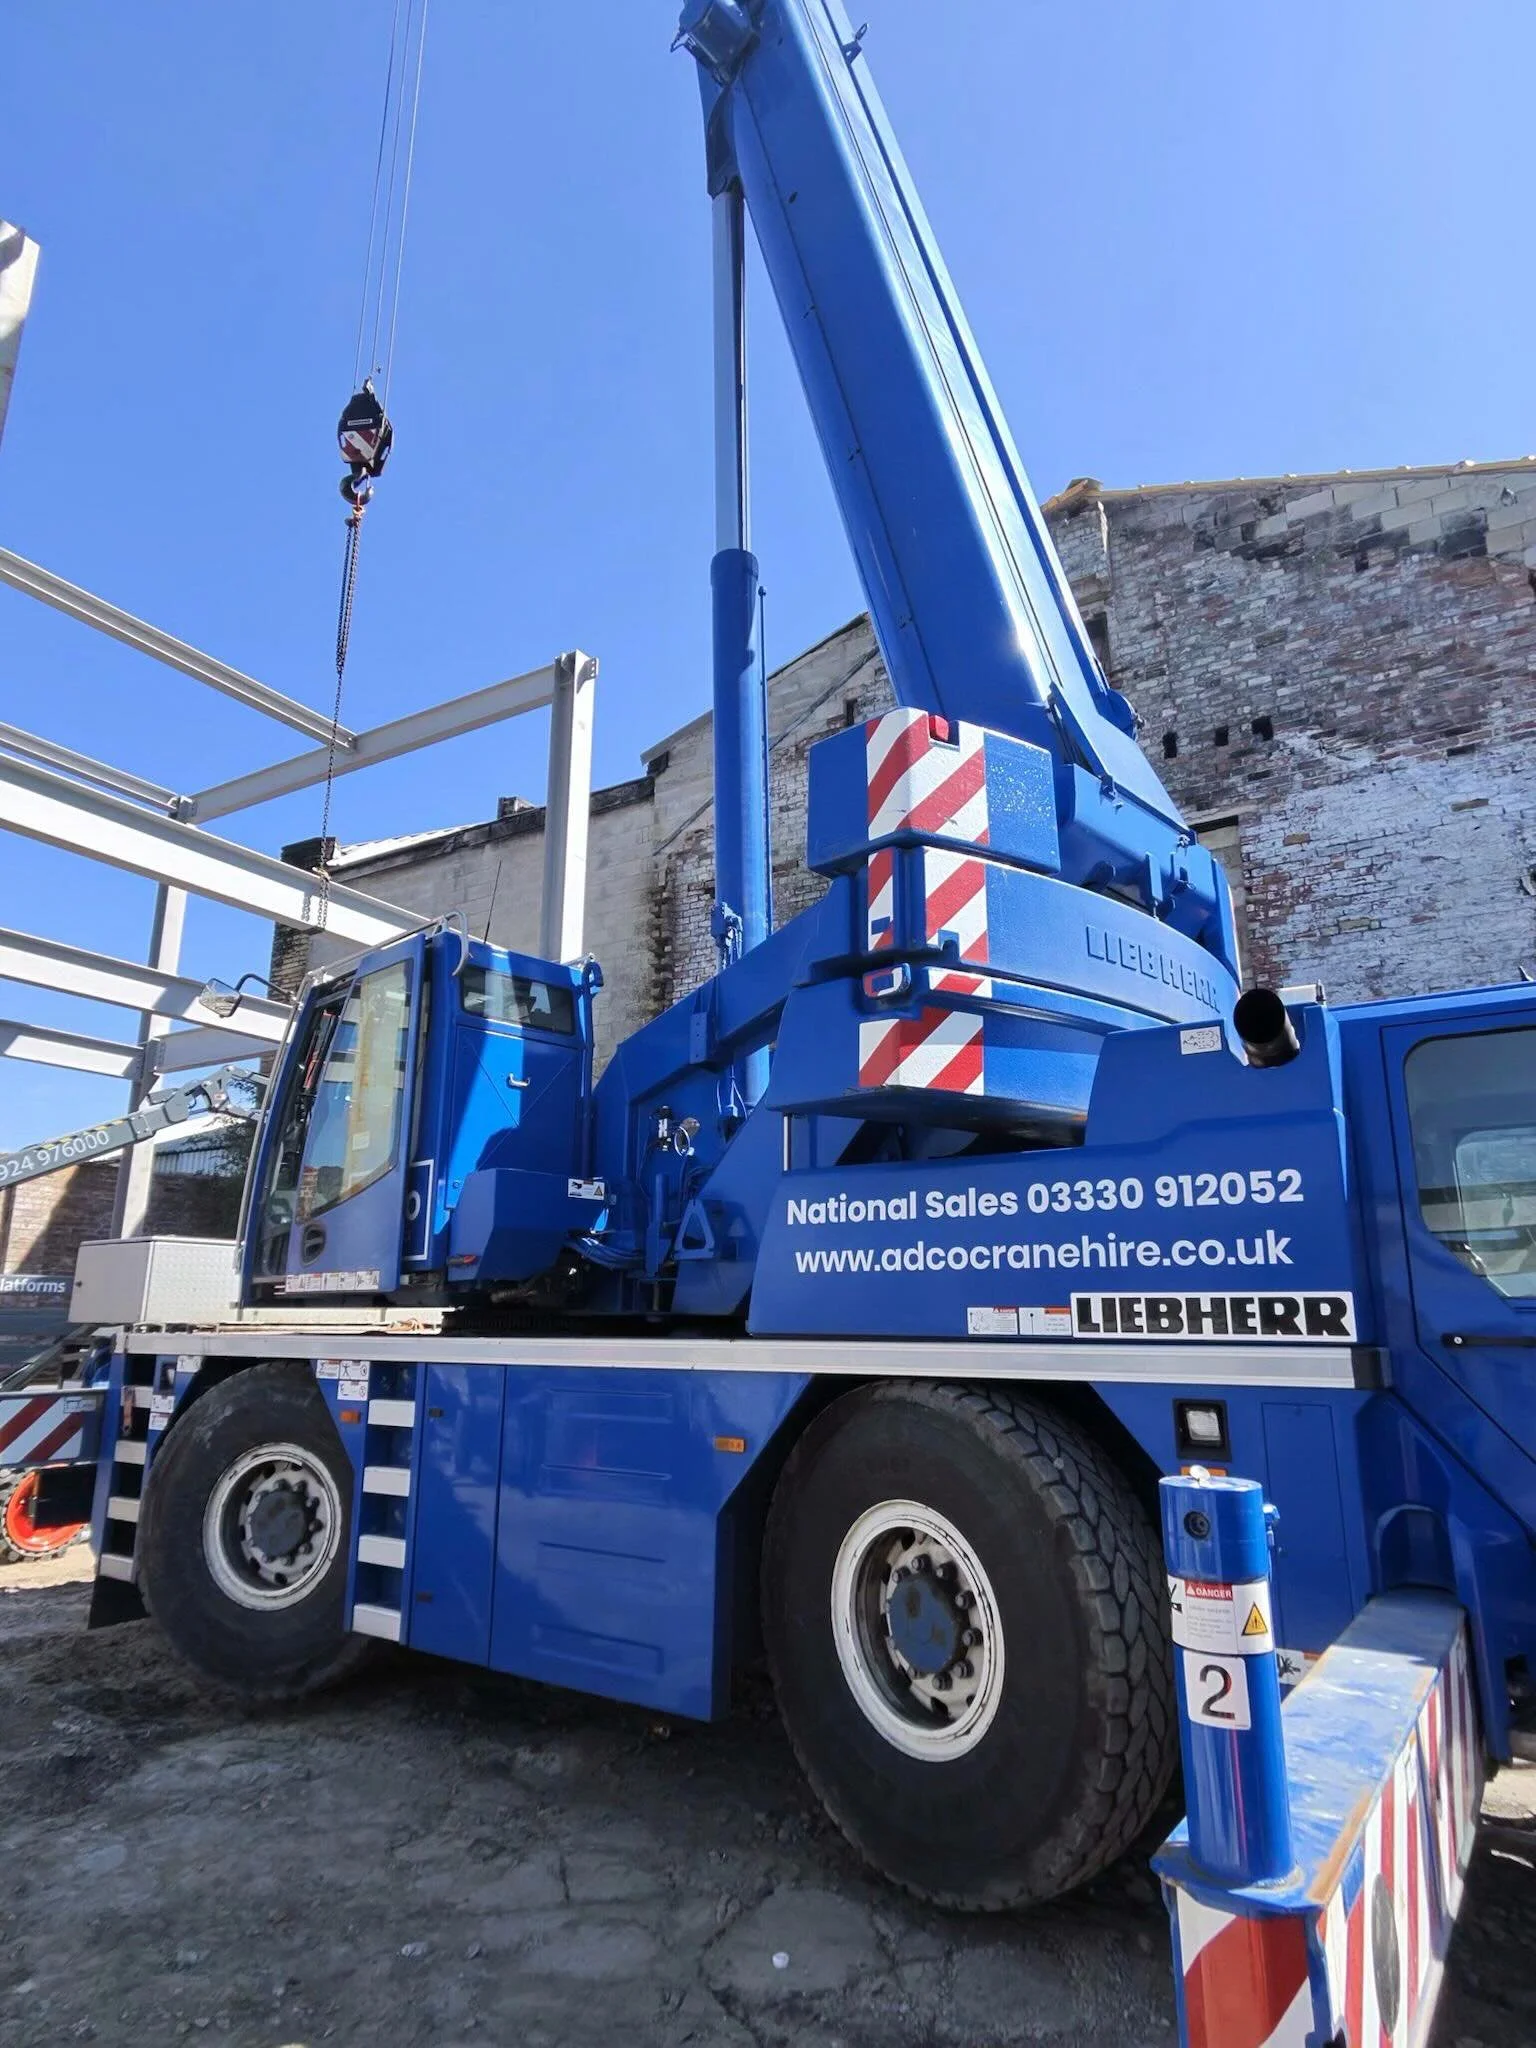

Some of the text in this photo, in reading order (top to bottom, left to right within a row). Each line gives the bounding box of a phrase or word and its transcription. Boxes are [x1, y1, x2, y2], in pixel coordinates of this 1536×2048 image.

[1085, 924, 1221, 1015] LIEBHERR
[36, 1130, 110, 1166] 976000
[786, 1168, 1304, 1226] National Sales 03330 912052
[795, 1229, 1294, 1274] www.adcocranehire.co.uk
[1075, 1296, 1352, 1338] LIEBHERR
[1195, 1586, 1233, 1598] DANGER
[1199, 1664, 1235, 1720] 2
